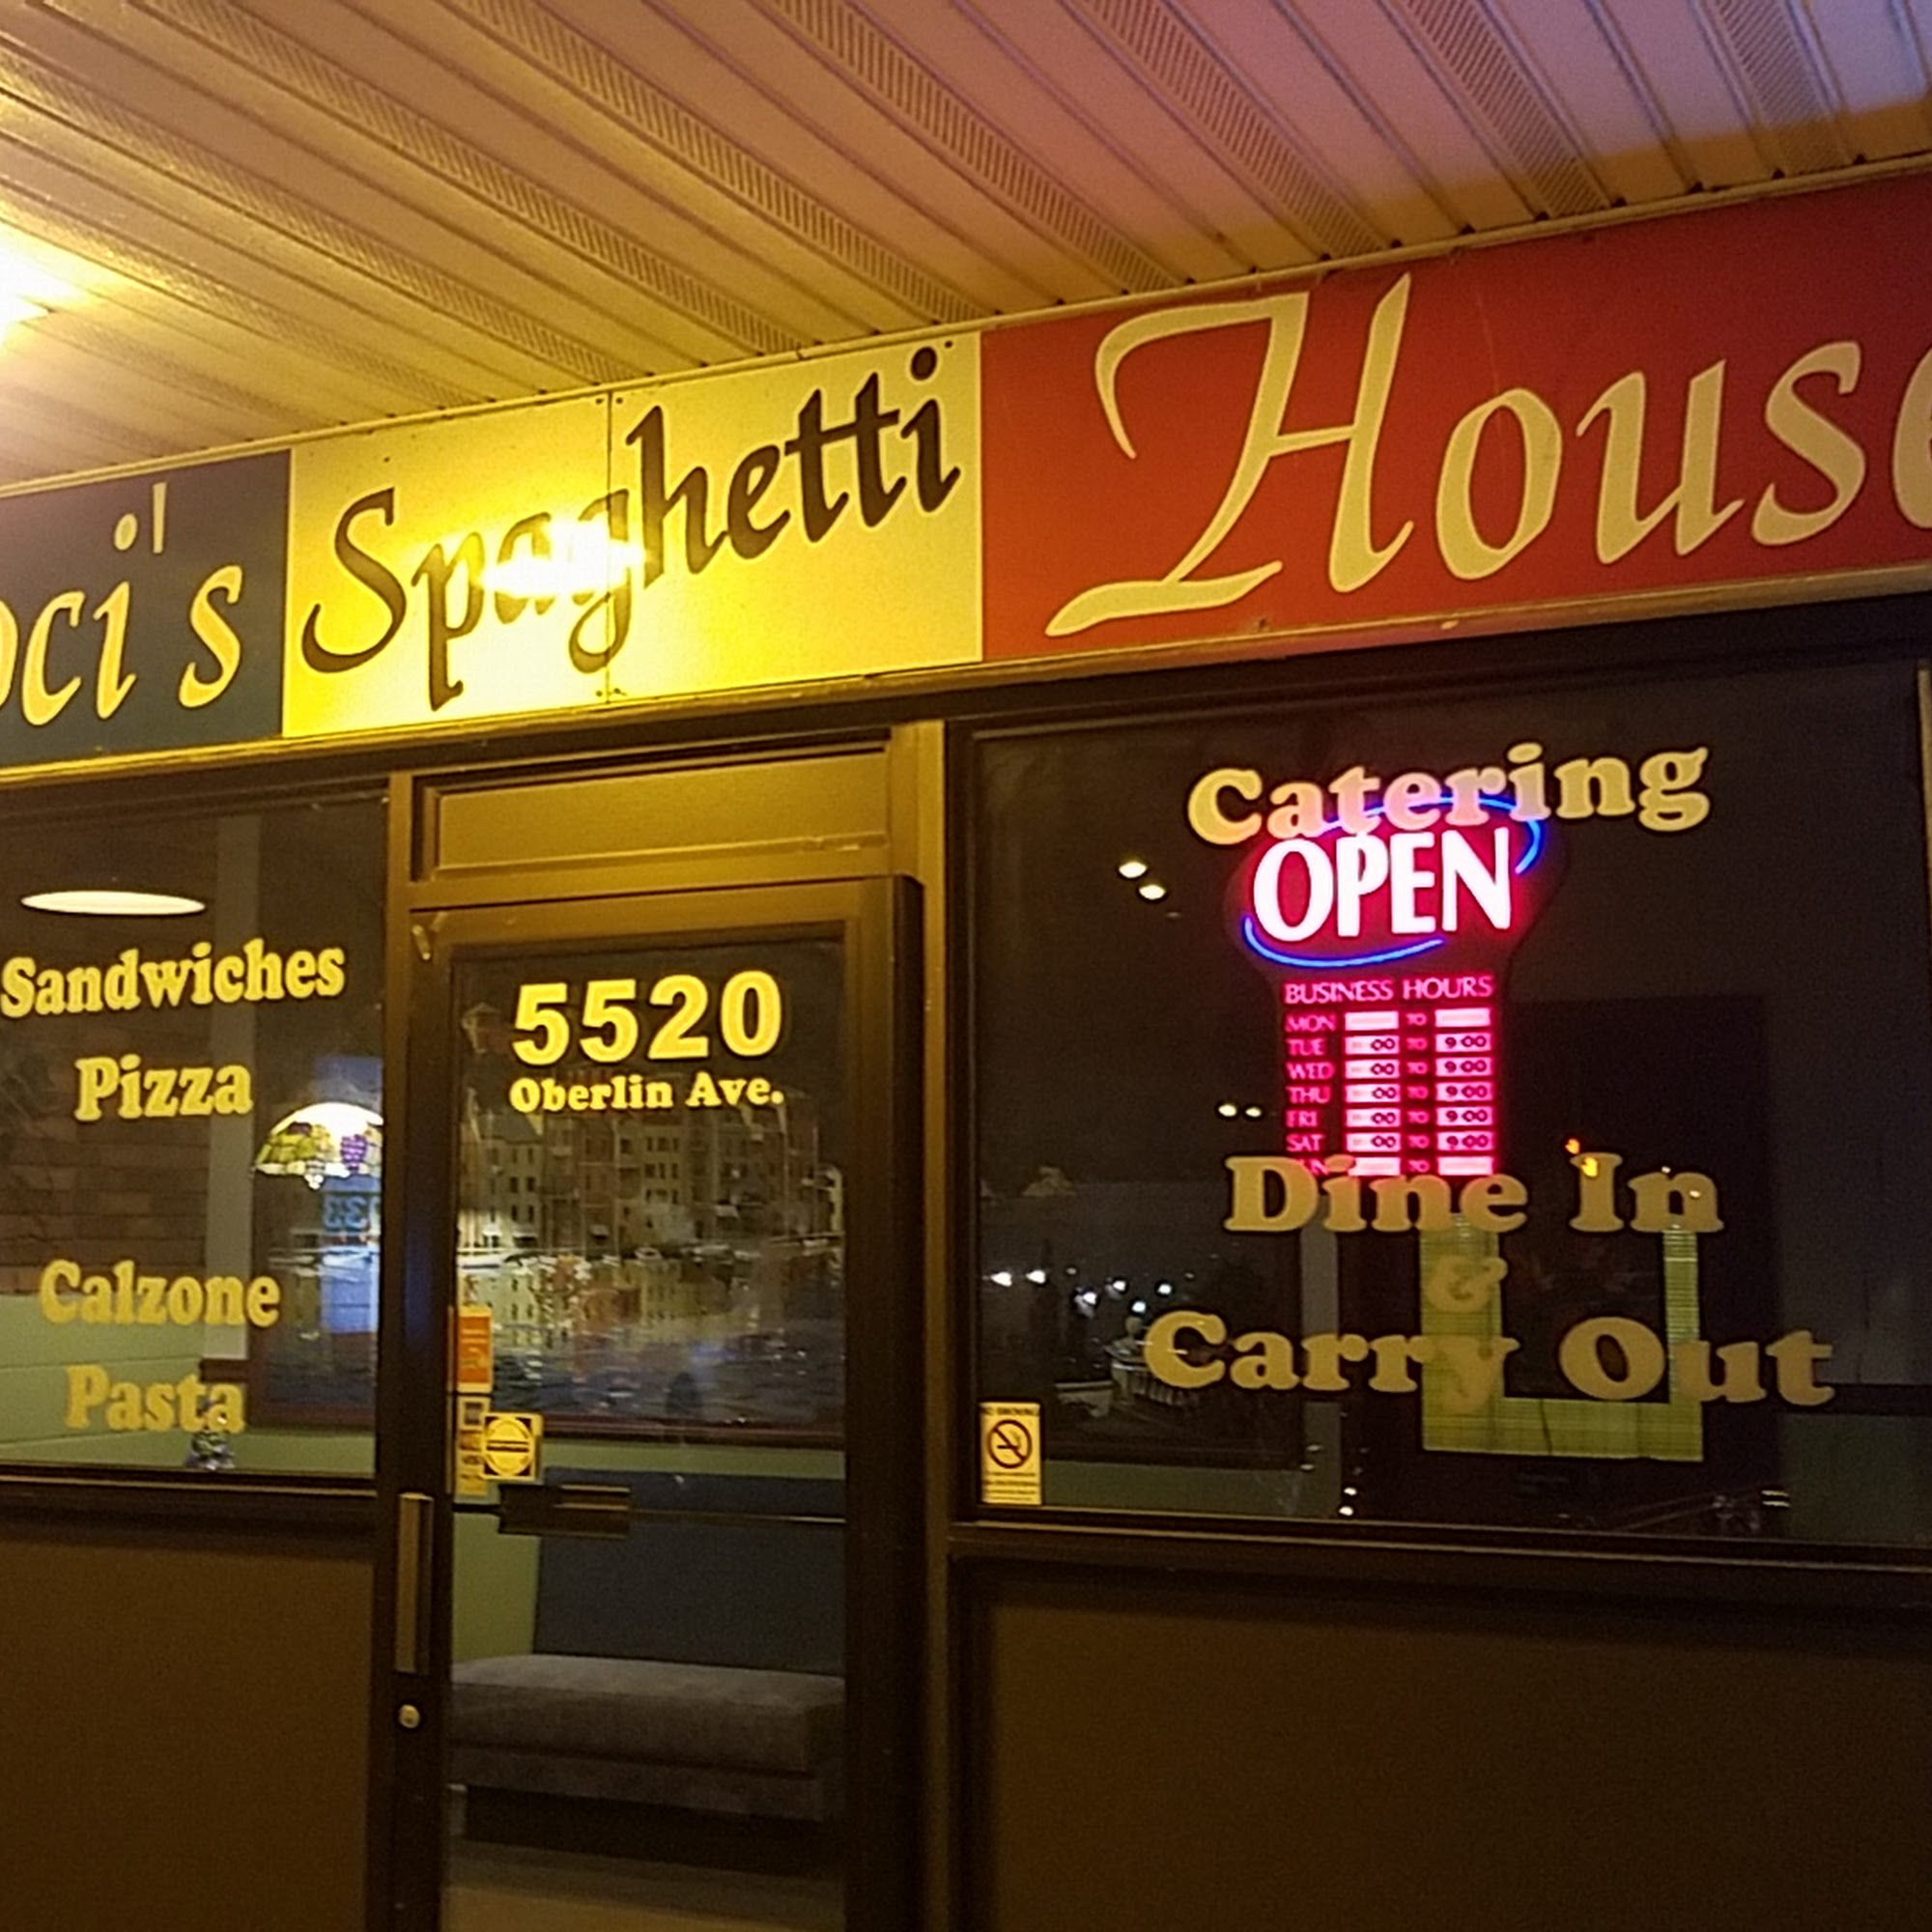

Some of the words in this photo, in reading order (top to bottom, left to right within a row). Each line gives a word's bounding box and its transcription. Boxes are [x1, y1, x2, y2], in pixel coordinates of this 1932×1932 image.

[0, 482, 242, 725] ci's
[301, 345, 961, 712] Spaghetti
[1187, 742, 1710, 845] Catering
[1252, 826, 1512, 942] OPEN
[0, 937, 346, 1019] Sandwiches
[1284, 980, 1395, 1005] BUSINESS
[1403, 975, 1493, 1001] HOURS
[511, 969, 783, 1065] 5520
[1285, 1013, 1336, 1033] MON
[1285, 1037, 1325, 1057] TUE
[73, 1054, 254, 1122] Pizza
[508, 1074, 674, 1113] Oberlin
[685, 1070, 785, 1110] Ave.
[1285, 1061, 1336, 1080] WED
[1285, 1085, 1332, 1104] THU
[1285, 1109, 1319, 1128] FRI
[1285, 1133, 1326, 1152] SAT
[1222, 1153, 1529, 1233] Dine
[1569, 1152, 1724, 1233] In
[39, 1260, 282, 1327] Calzone
[1423, 1254, 1510, 1313] &
[1144, 1311, 1520, 1417] Carry
[1558, 1316, 1836, 1406] Out
[65, 1364, 247, 1435] Pasta
